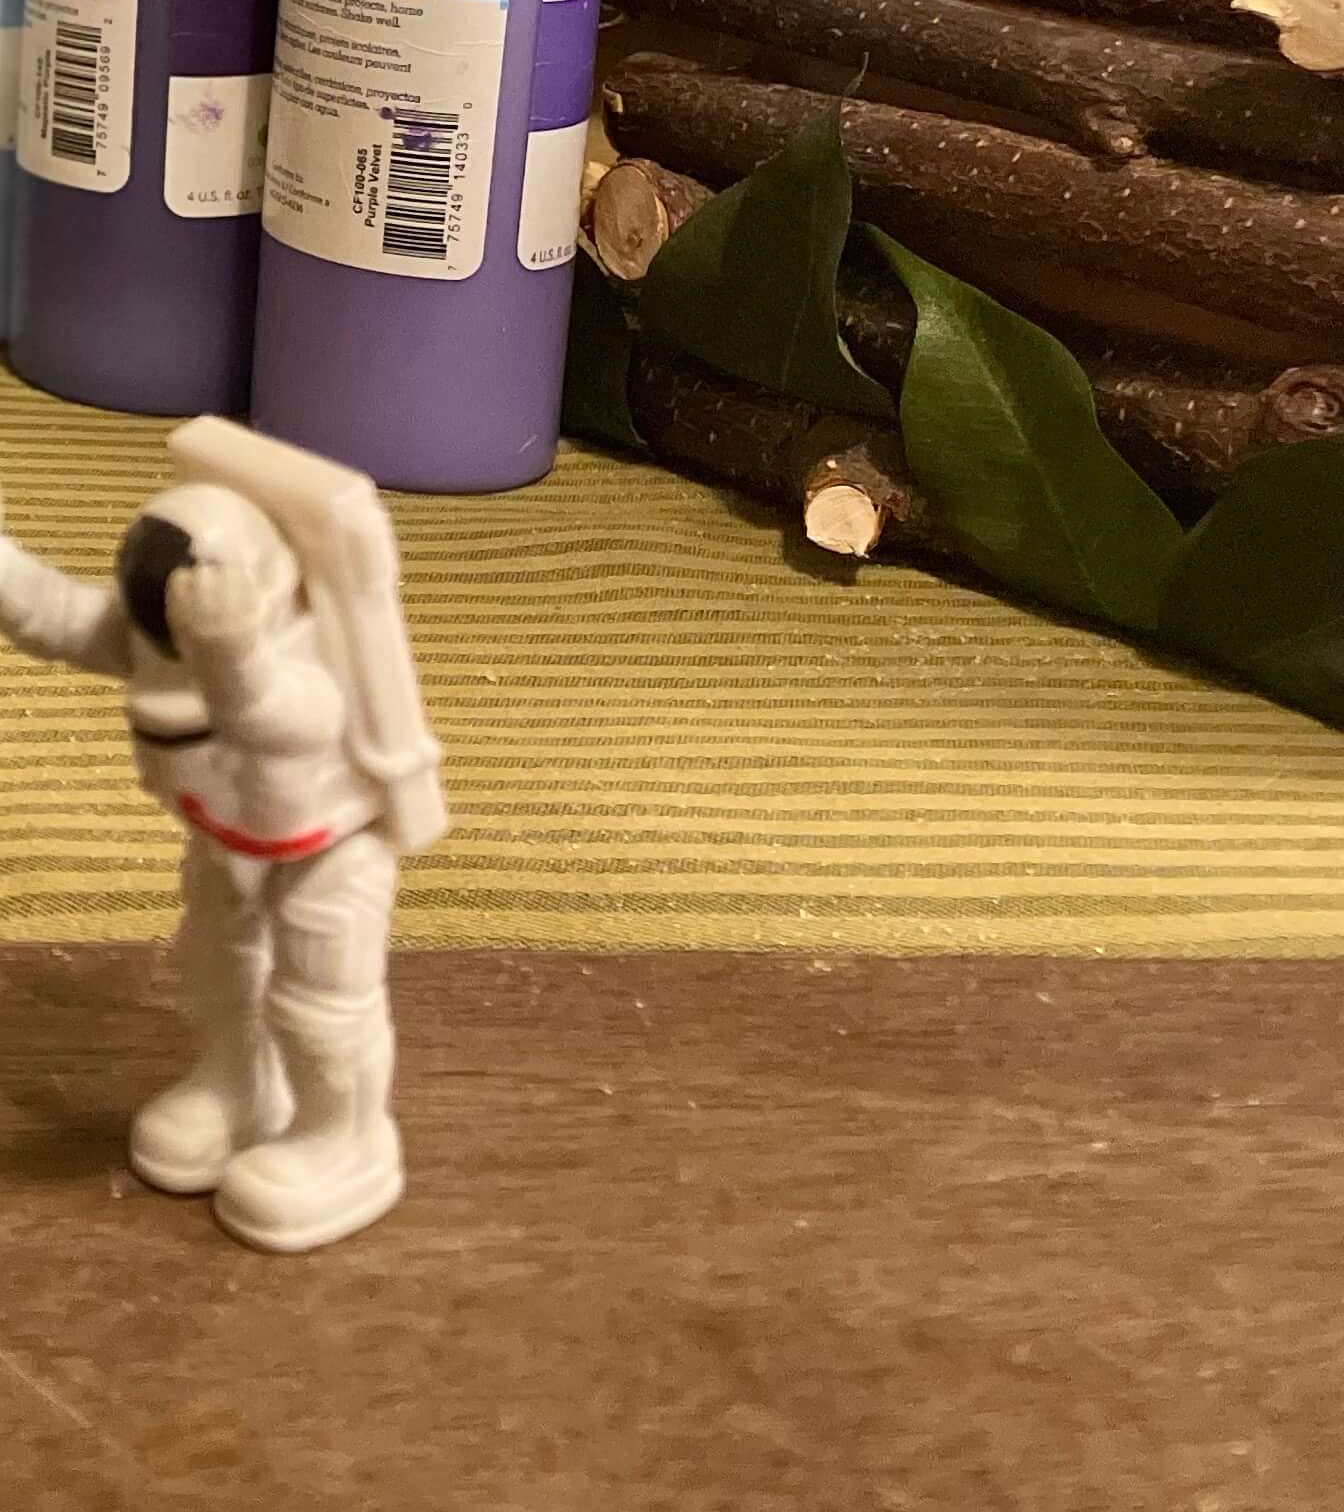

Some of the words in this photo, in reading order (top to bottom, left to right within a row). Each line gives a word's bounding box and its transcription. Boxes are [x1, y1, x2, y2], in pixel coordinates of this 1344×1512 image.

[390, 1, 424, 17] home
[99, 45, 111, 93] 09569
[365, 56, 412, 73] peuvent
[366, 85, 421, 104] proyectos
[96, 103, 109, 149] 75749
[368, 143, 383, 181] Velvet
[453, 132, 470, 180] 14033
[352, 148, 368, 214] CF100-065
[364, 185, 378, 228] Purple
[447, 193, 463, 243] 75749
